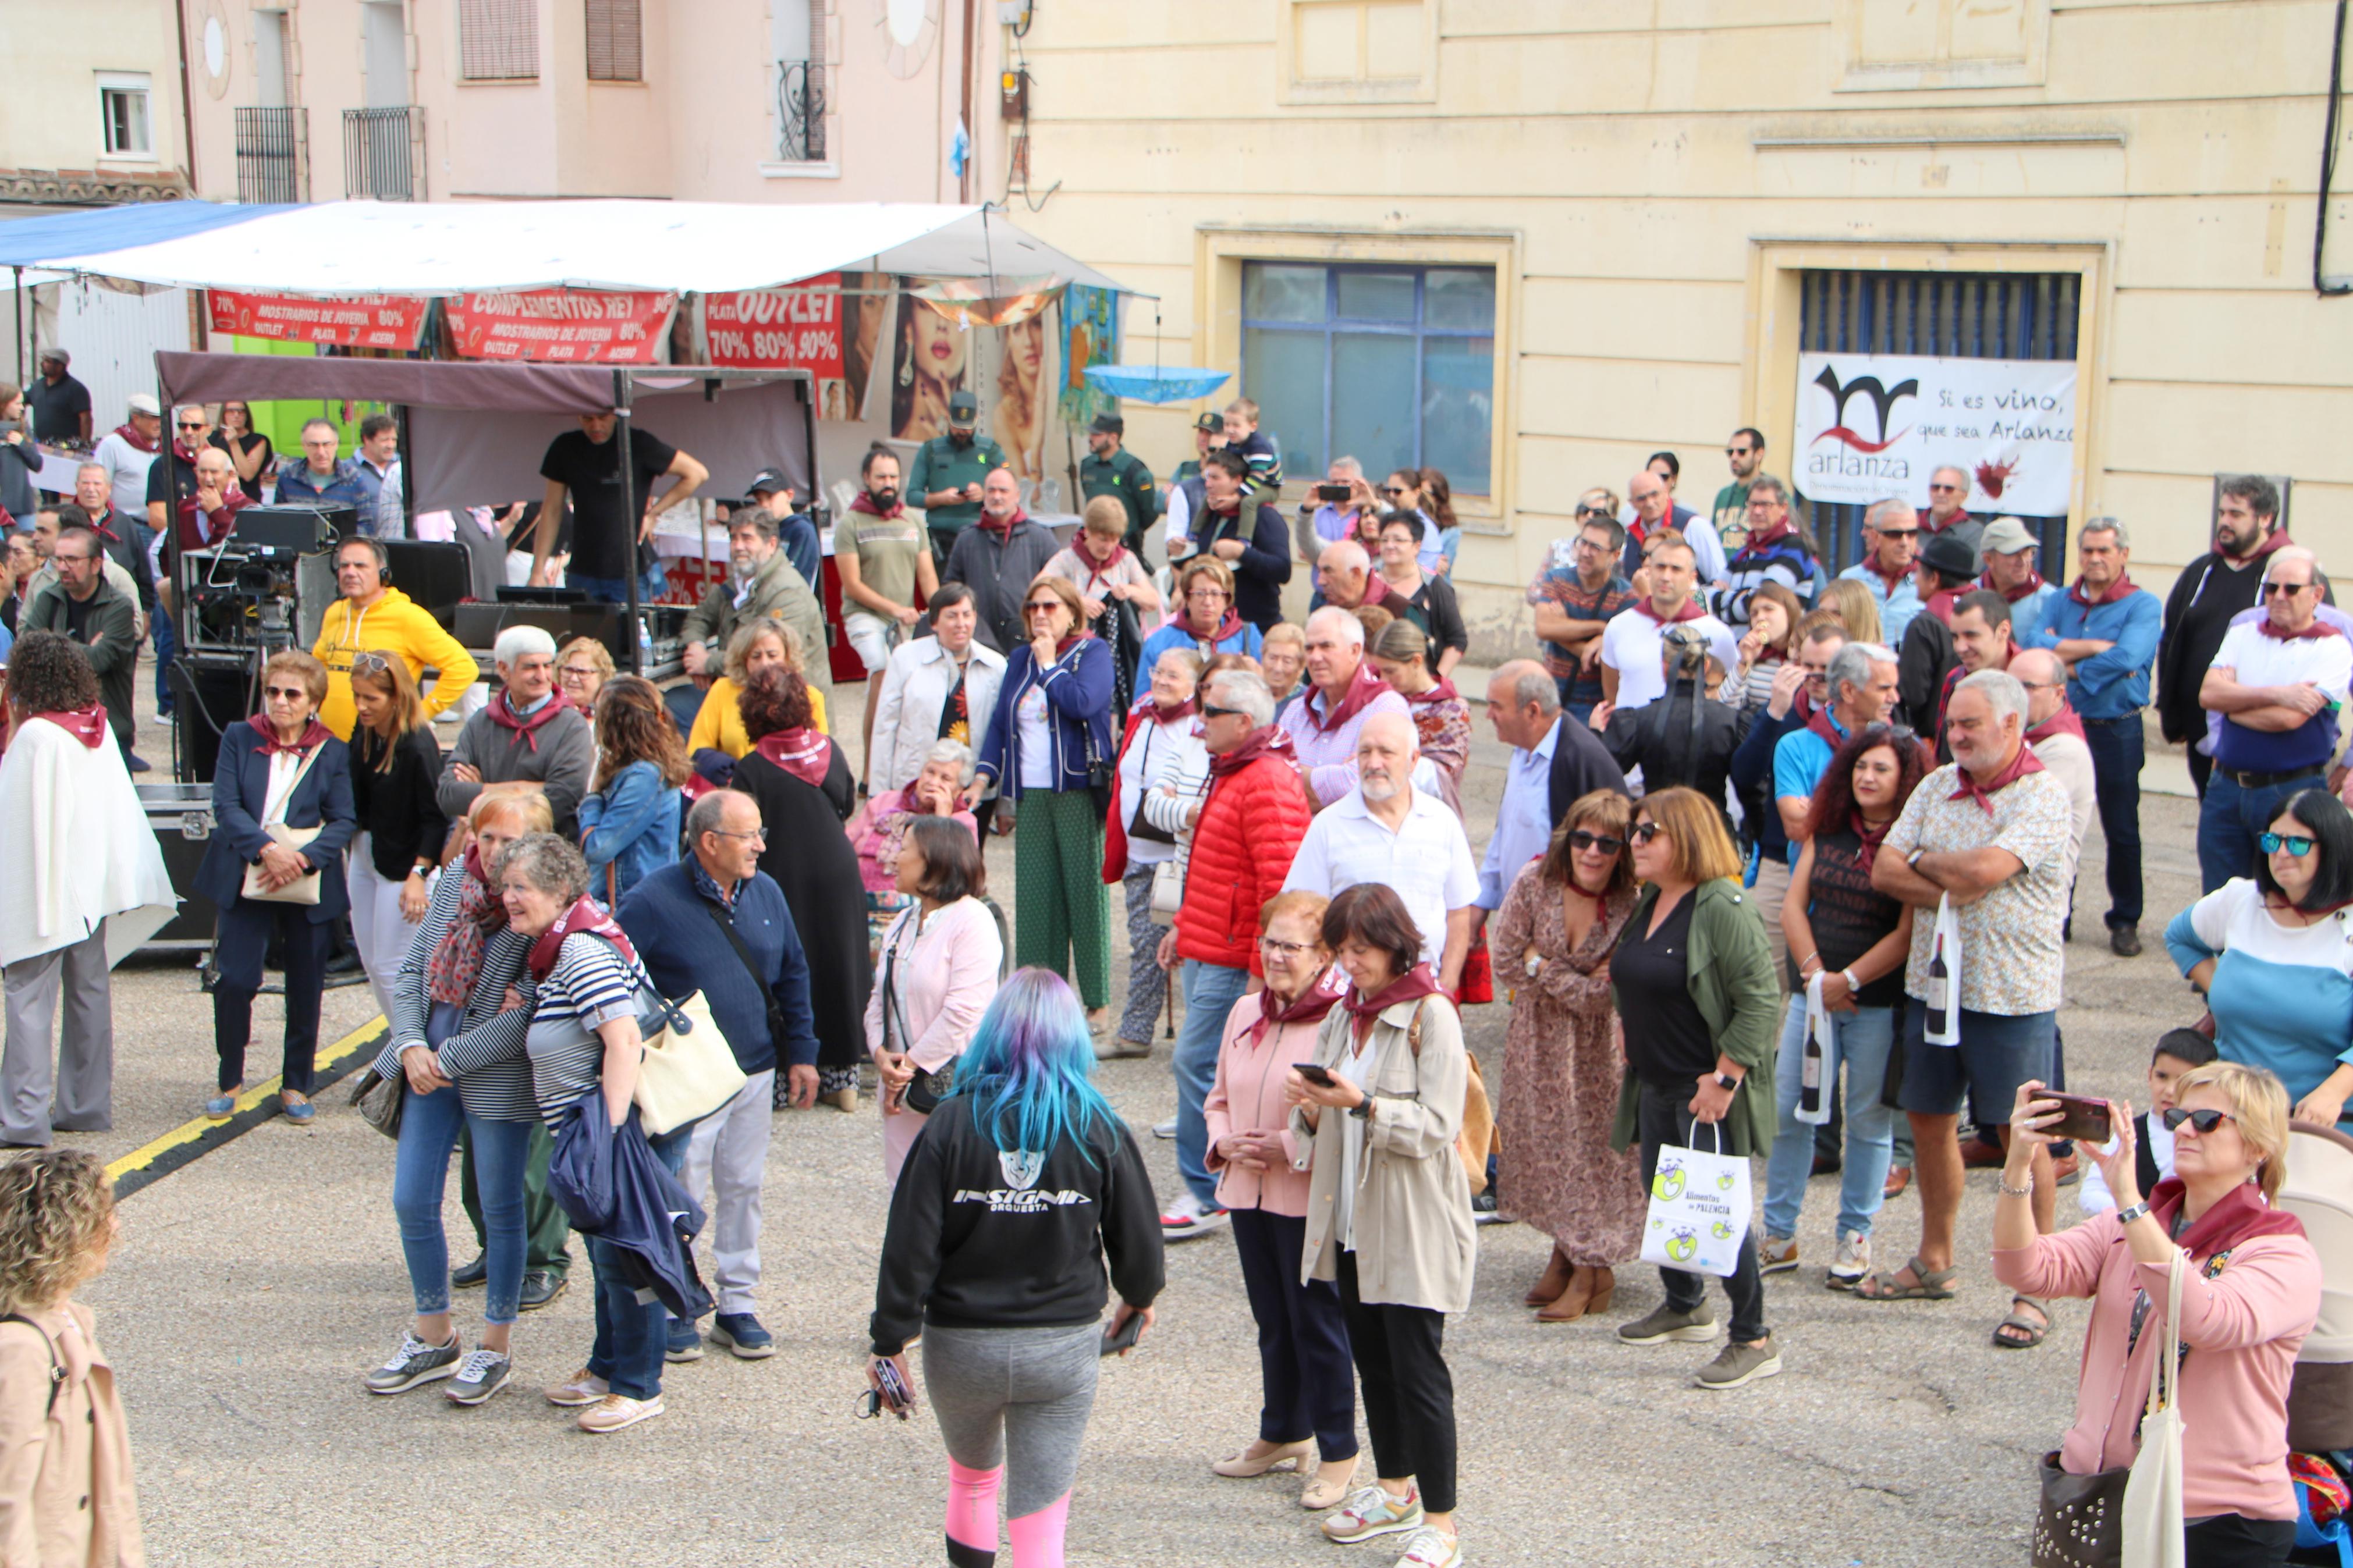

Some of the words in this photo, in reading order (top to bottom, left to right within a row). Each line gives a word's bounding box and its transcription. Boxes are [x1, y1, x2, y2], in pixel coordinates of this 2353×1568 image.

[216, 296, 236, 313] 70%
[473, 293, 602, 319] COMPLEMENTOS
[606, 296, 633, 319] REY
[708, 305, 736, 320] PLATA
[736, 285, 840, 323] OUTLET
[258, 305, 319, 322] MOSTRARIOS
[320, 310, 333, 323] DE
[333, 311, 370, 326] JOYERIA
[378, 310, 404, 328] 80%
[254, 322, 283, 336] OUTLET
[311, 327, 336, 340] PLATA
[369, 331, 396, 344] ACERO
[491, 323, 559, 341] MOSTRARIOS
[560, 327, 575, 341] DE
[575, 328, 612, 342] JOYERIA
[619, 323, 645, 340] 80%
[483, 342, 519, 355] OUTLET
[547, 346, 575, 358] PLATA
[608, 347, 636, 359] ACERO
[709, 331, 750, 359] 70%
[753, 331, 796, 360] 80%
[798, 330, 838, 360] 90%
[1939, 389, 1953, 407] Si
[1964, 396, 1983, 407] es
[1994, 389, 2063, 414] vino,
[1918, 424, 1946, 443] que
[1954, 426, 1979, 439] sea
[1809, 438, 1909, 479] arlanza
[953, 1189, 1092, 1205] INSIGNIA
[1685, 1192, 1720, 1203] Alimentos
[990, 1203, 1049, 1213] ORQUESTA
[1695, 1204, 1731, 1215] PALENCIA
